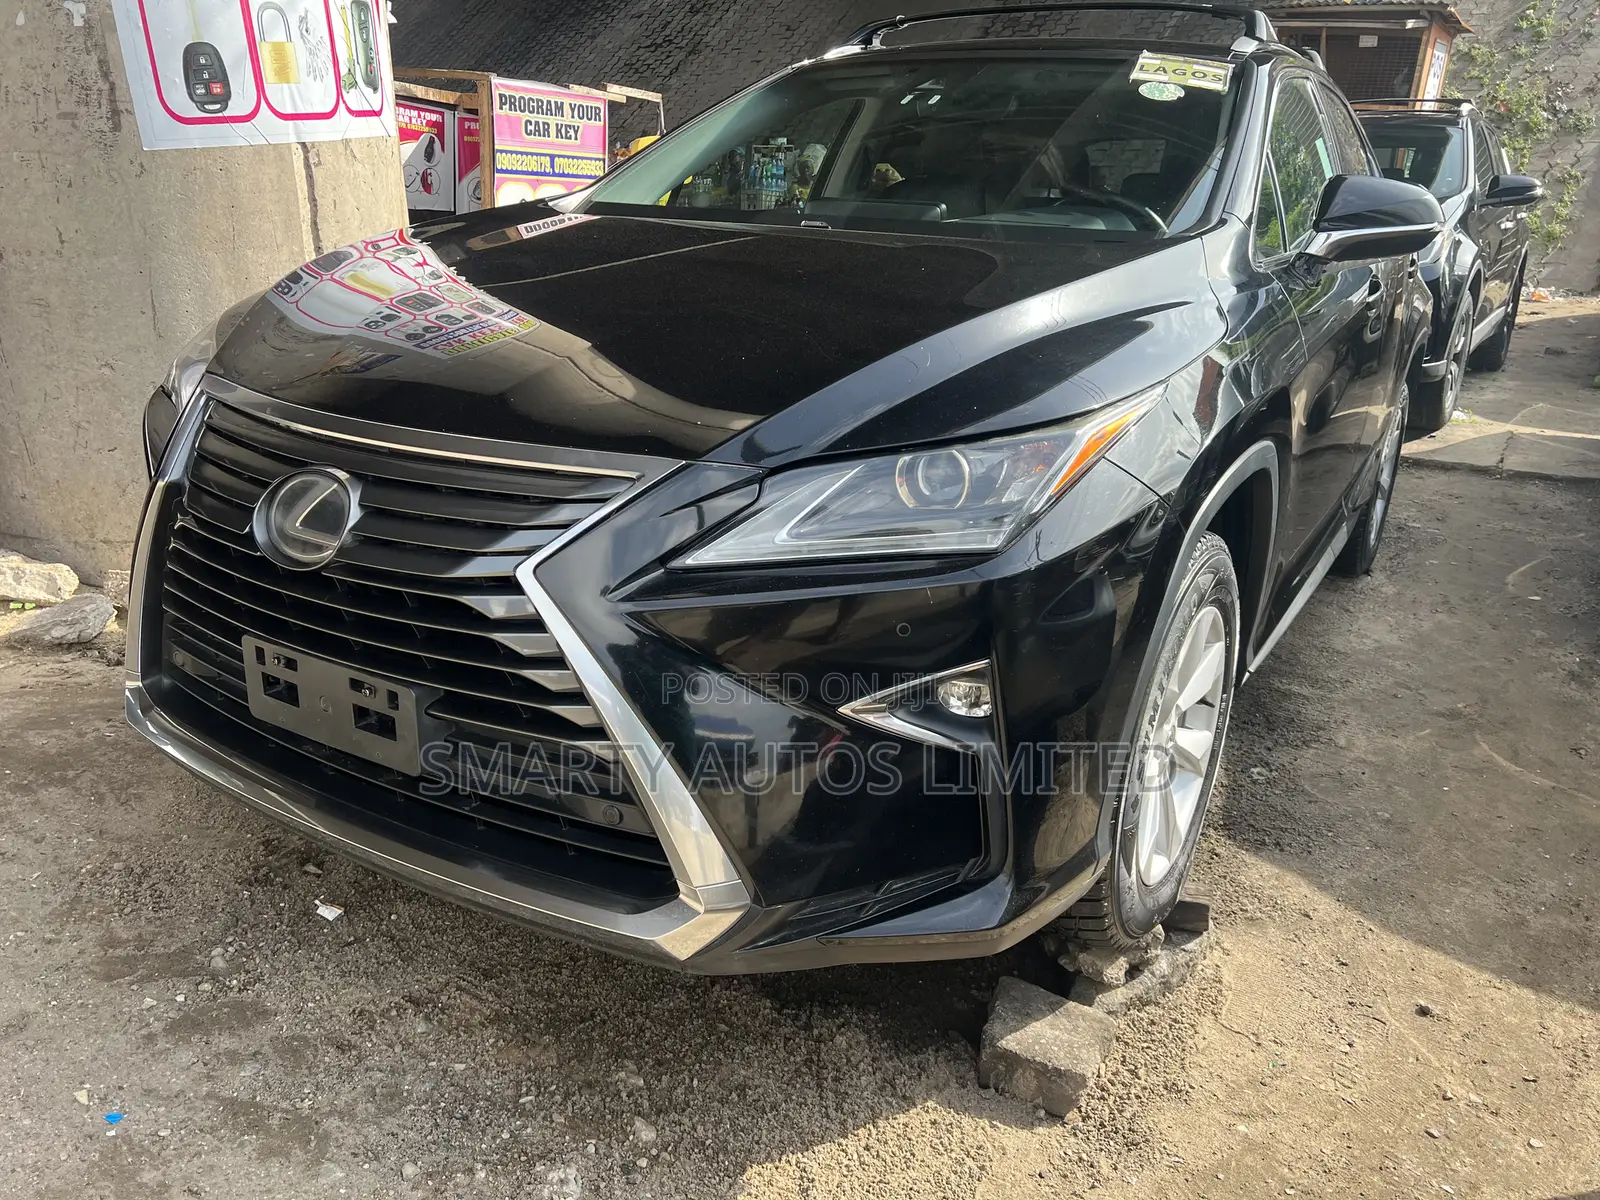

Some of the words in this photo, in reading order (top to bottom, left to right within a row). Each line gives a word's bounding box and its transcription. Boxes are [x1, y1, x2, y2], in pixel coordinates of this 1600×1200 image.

[1138, 64, 1223, 82] LAGOS
[498, 93, 565, 118] PROGRAM
[568, 102, 602, 122] YOUR
[411, 117, 427, 126] KEY
[420, 112, 442, 122] YOUR
[524, 119, 551, 138] CAR
[555, 122, 581, 141] KEY
